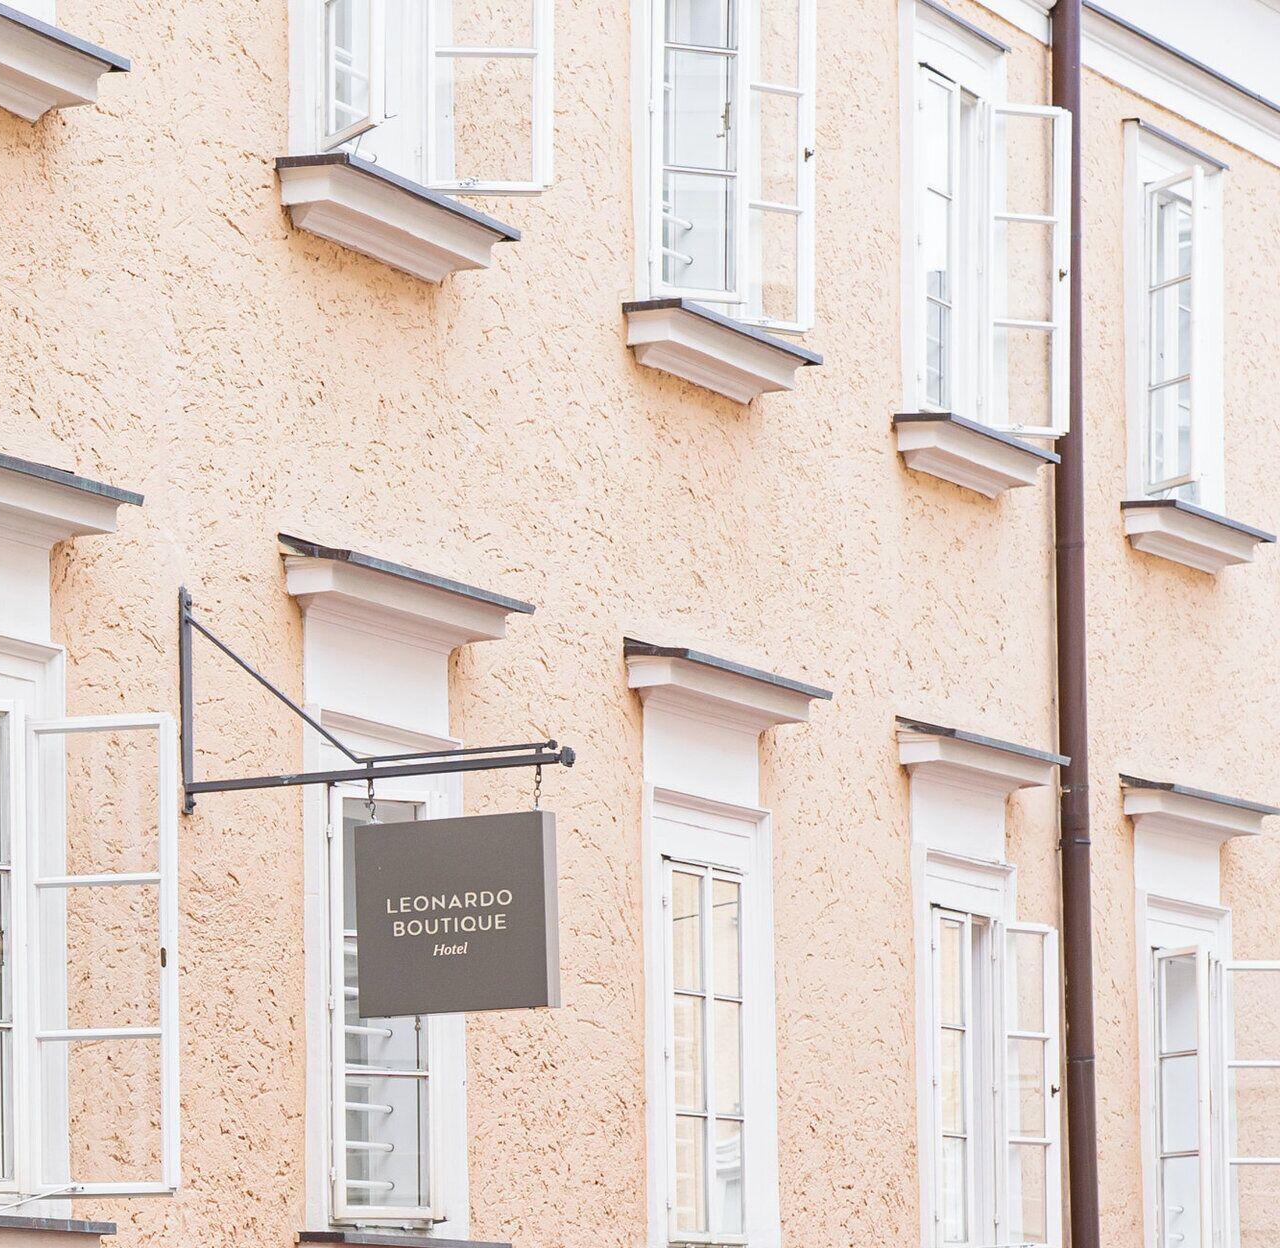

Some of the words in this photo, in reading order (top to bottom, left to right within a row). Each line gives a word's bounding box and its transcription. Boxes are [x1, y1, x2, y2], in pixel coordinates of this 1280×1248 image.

[386, 889, 513, 914] LEONARDO
[393, 913, 507, 937] BOUTIQUE
[432, 942, 468, 956] Hotel
